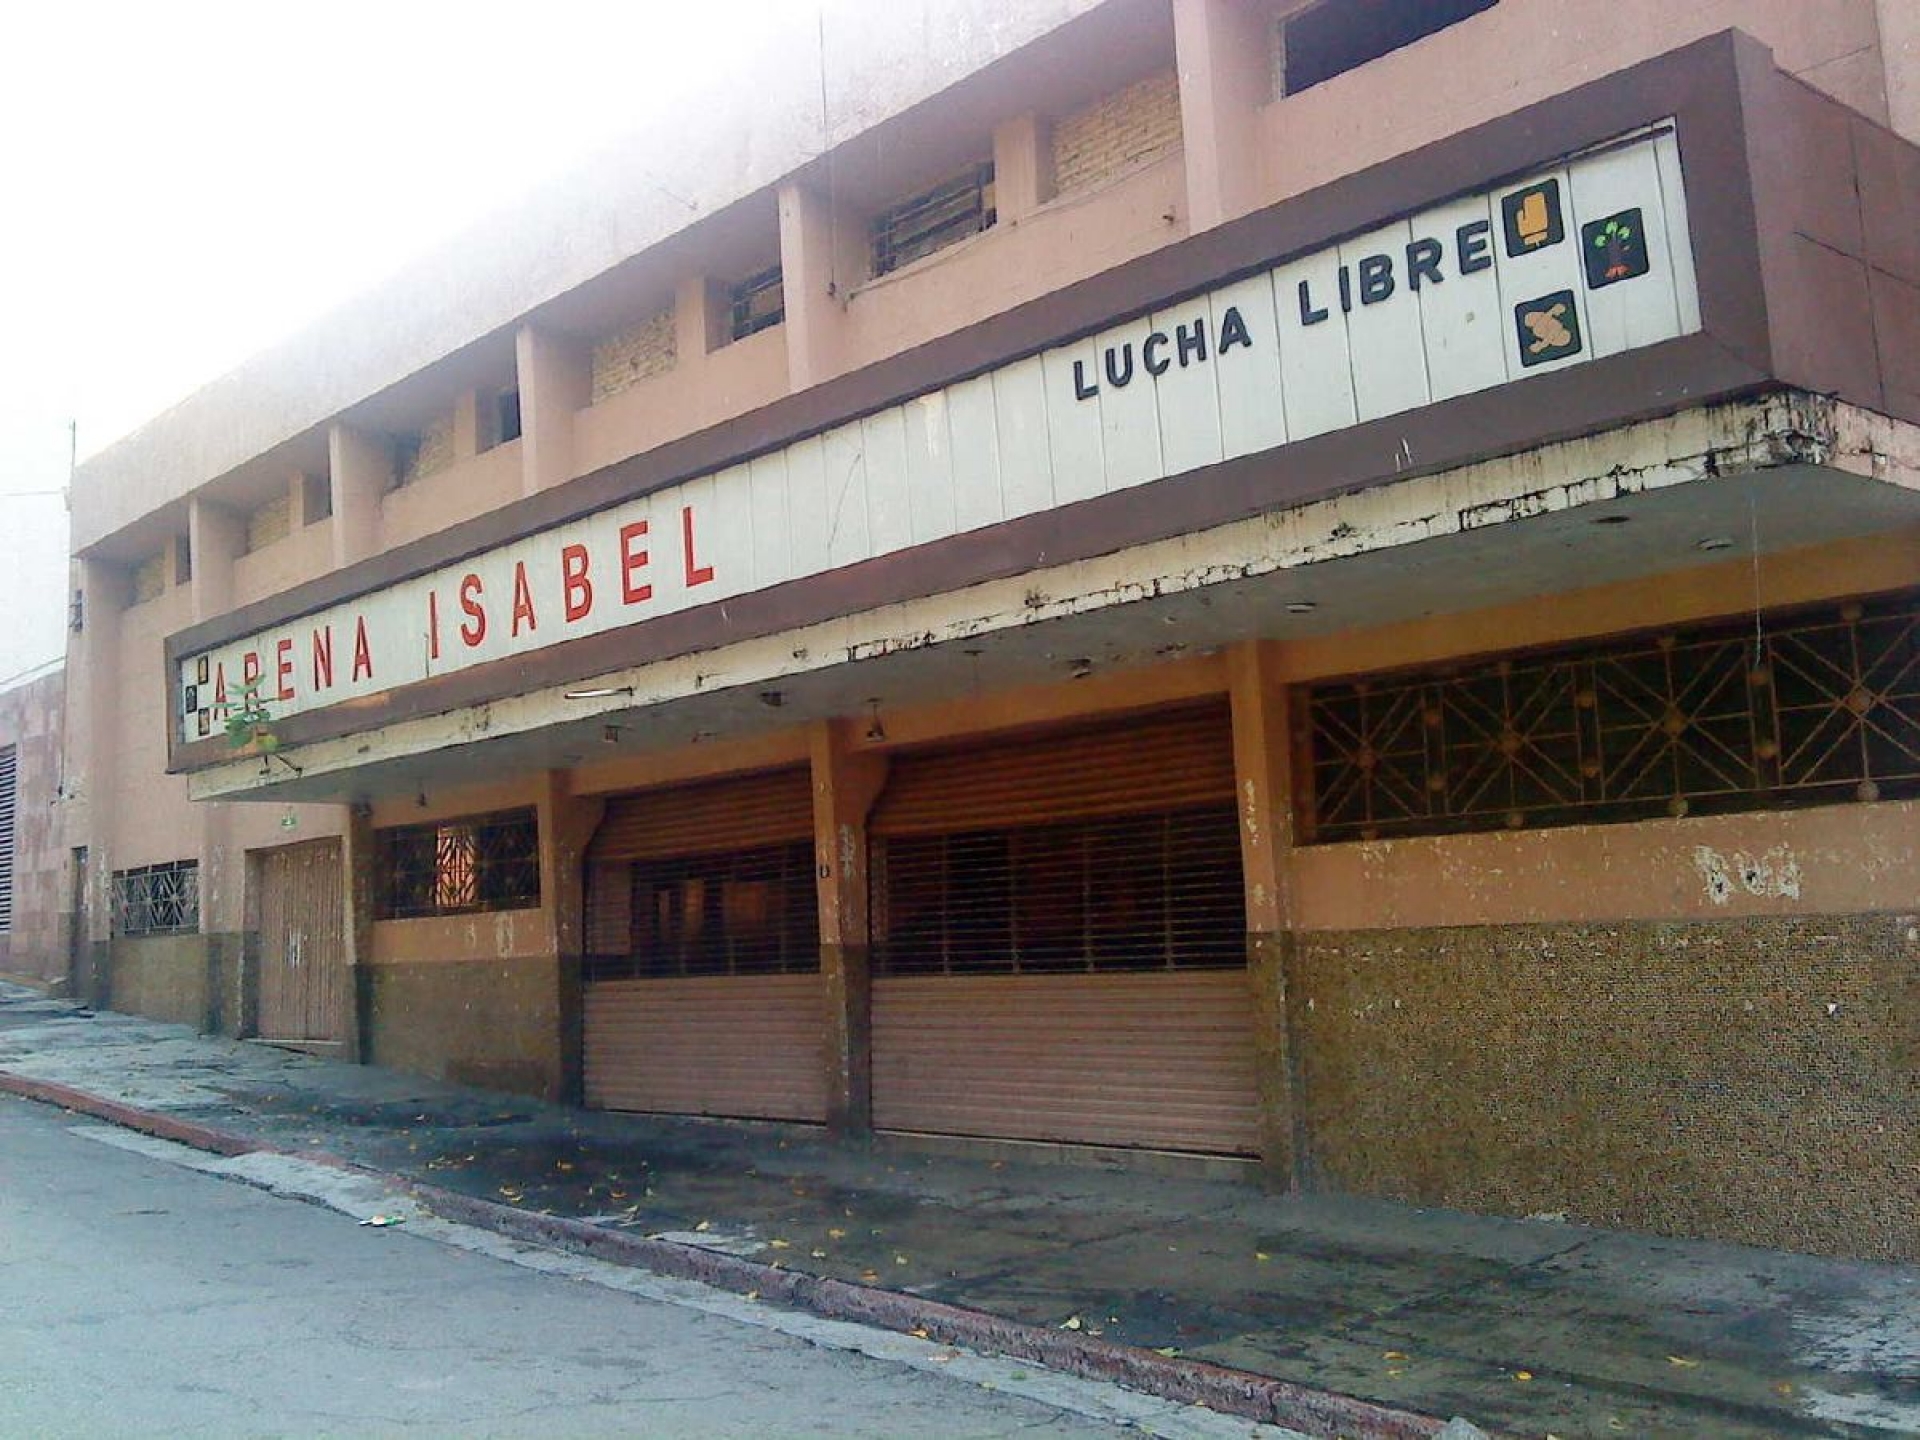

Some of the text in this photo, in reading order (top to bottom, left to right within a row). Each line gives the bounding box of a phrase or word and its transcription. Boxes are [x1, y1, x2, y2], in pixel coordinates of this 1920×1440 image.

[1073, 219, 1493, 401] LUCHA LIBRE
[213, 507, 715, 721] ARENA ISABEL
